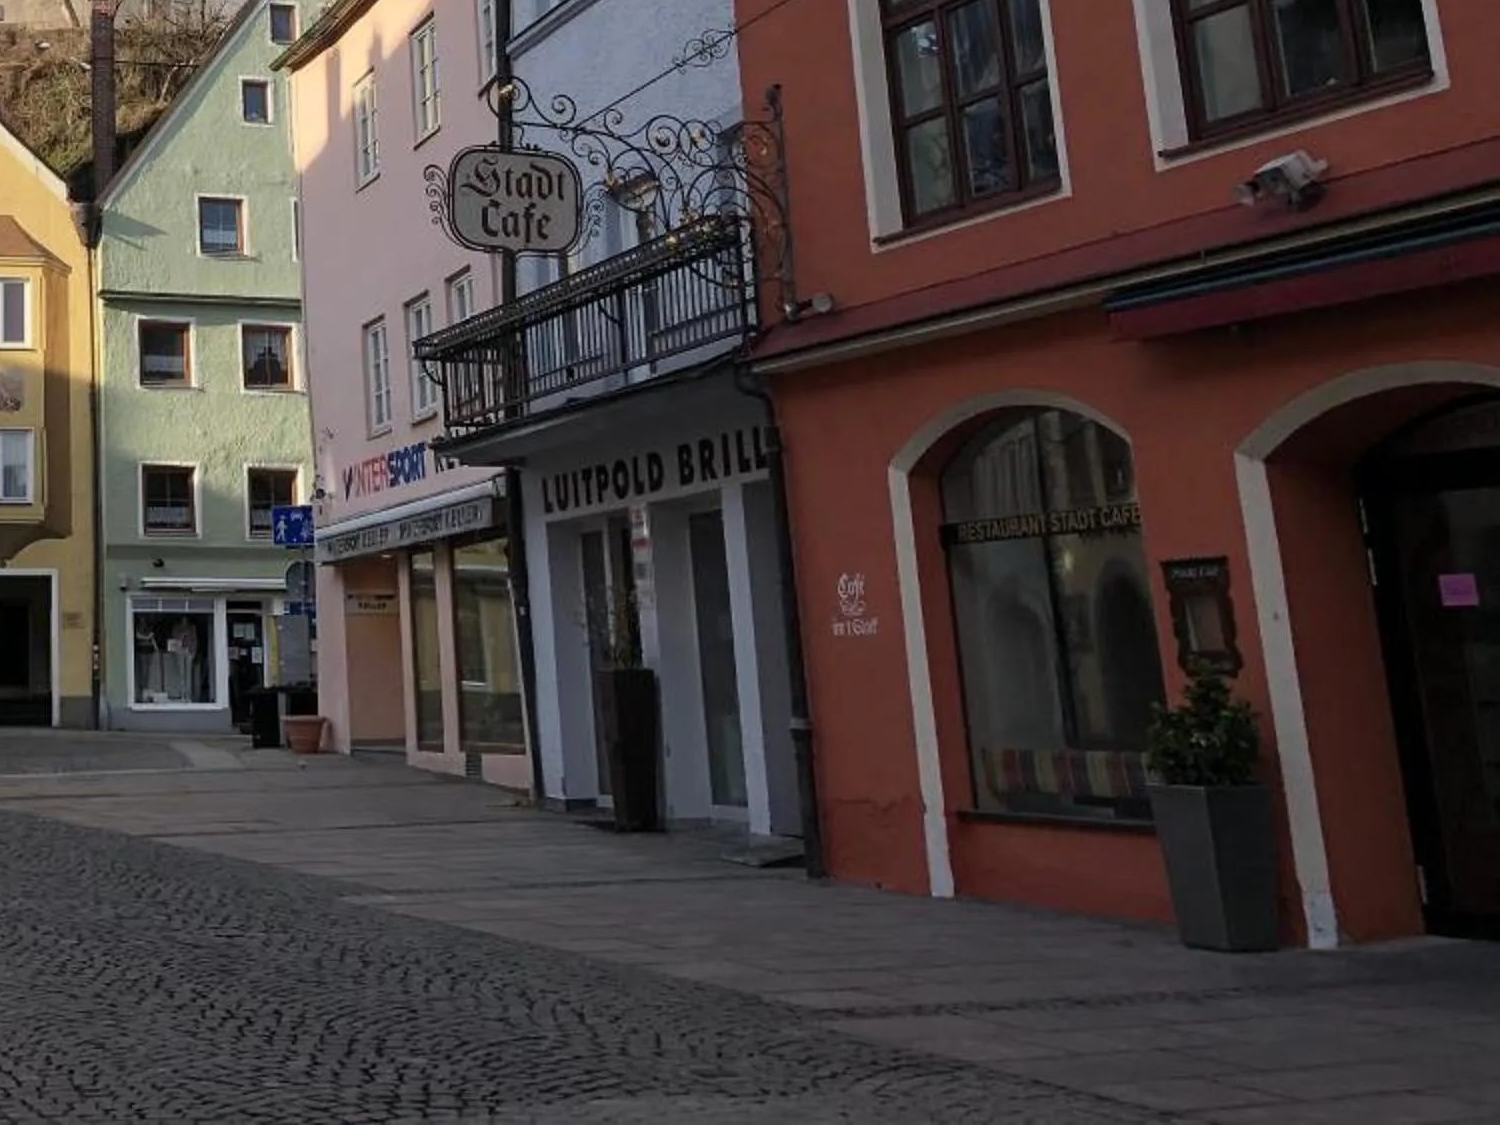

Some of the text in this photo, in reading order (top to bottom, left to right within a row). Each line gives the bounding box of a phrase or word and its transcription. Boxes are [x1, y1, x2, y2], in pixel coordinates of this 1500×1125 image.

[460, 156, 565, 200] Stadt
[541, 451, 664, 514] LUITPOLD
[957, 516, 1048, 541] RESTAURANT
[1050, 509, 1097, 532] STADT
